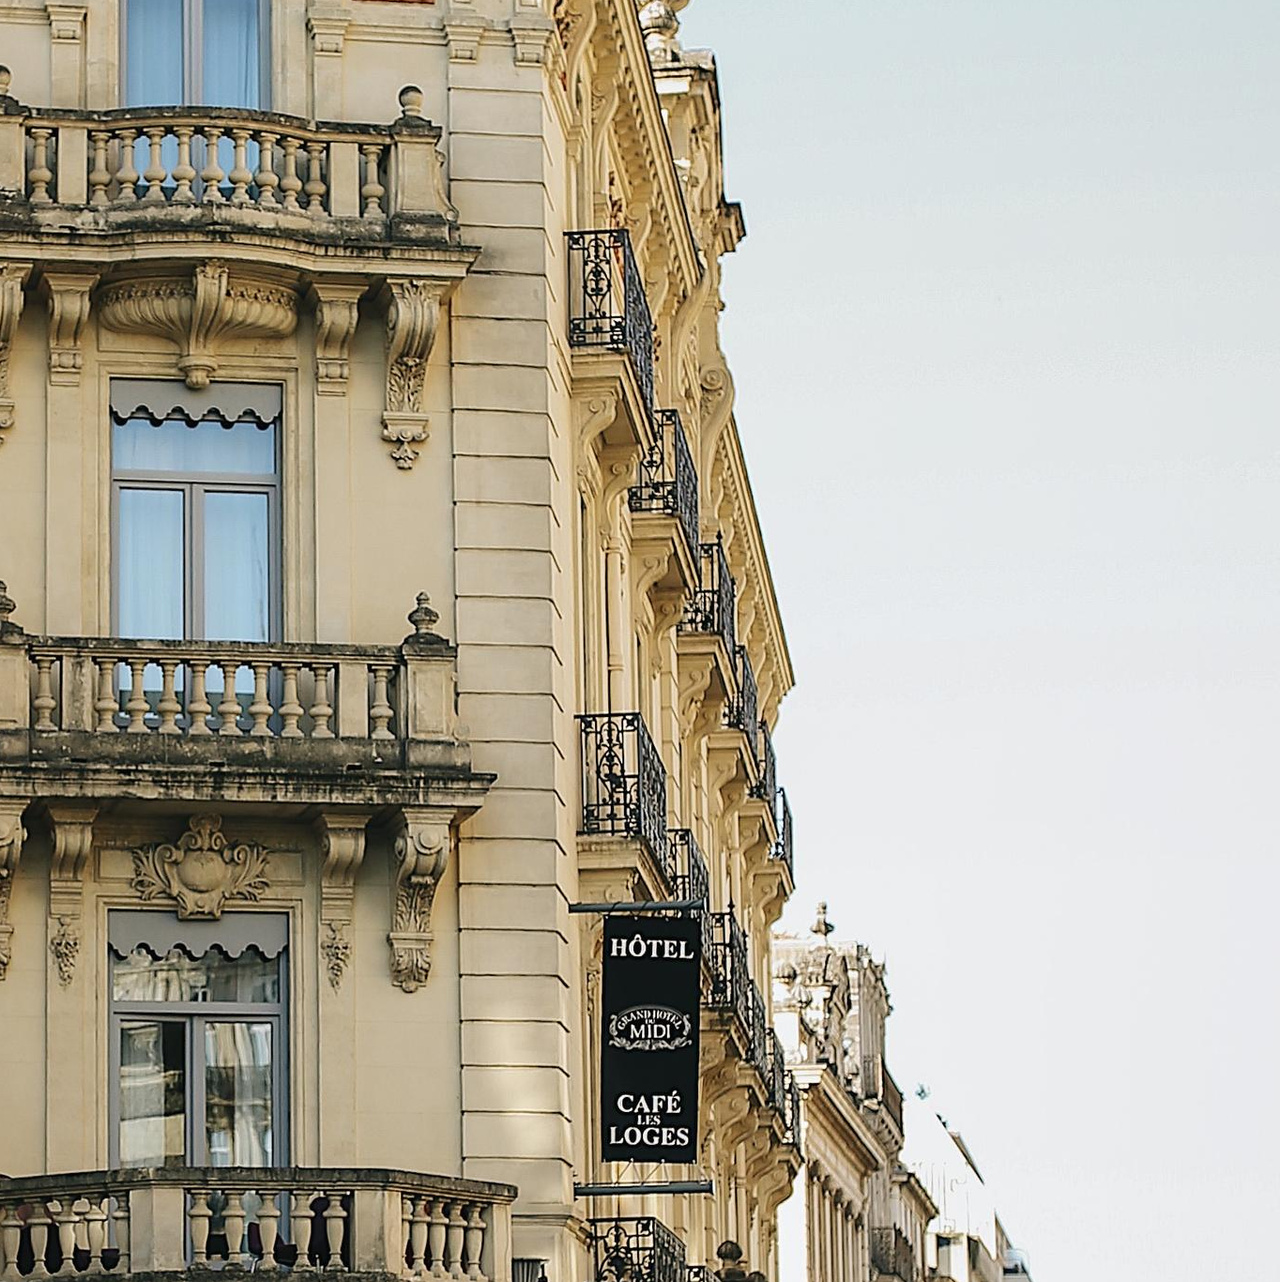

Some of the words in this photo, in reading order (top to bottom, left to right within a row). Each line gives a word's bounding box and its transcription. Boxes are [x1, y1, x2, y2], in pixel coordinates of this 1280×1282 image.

[610, 933, 695, 959] HÔTEL
[617, 1010, 651, 1030] GRAND
[630, 1024, 671, 1039] MIDI
[617, 1090, 681, 1113] CAFÉ
[637, 1114, 661, 1126] LES
[609, 1126, 689, 1146] LOGES
